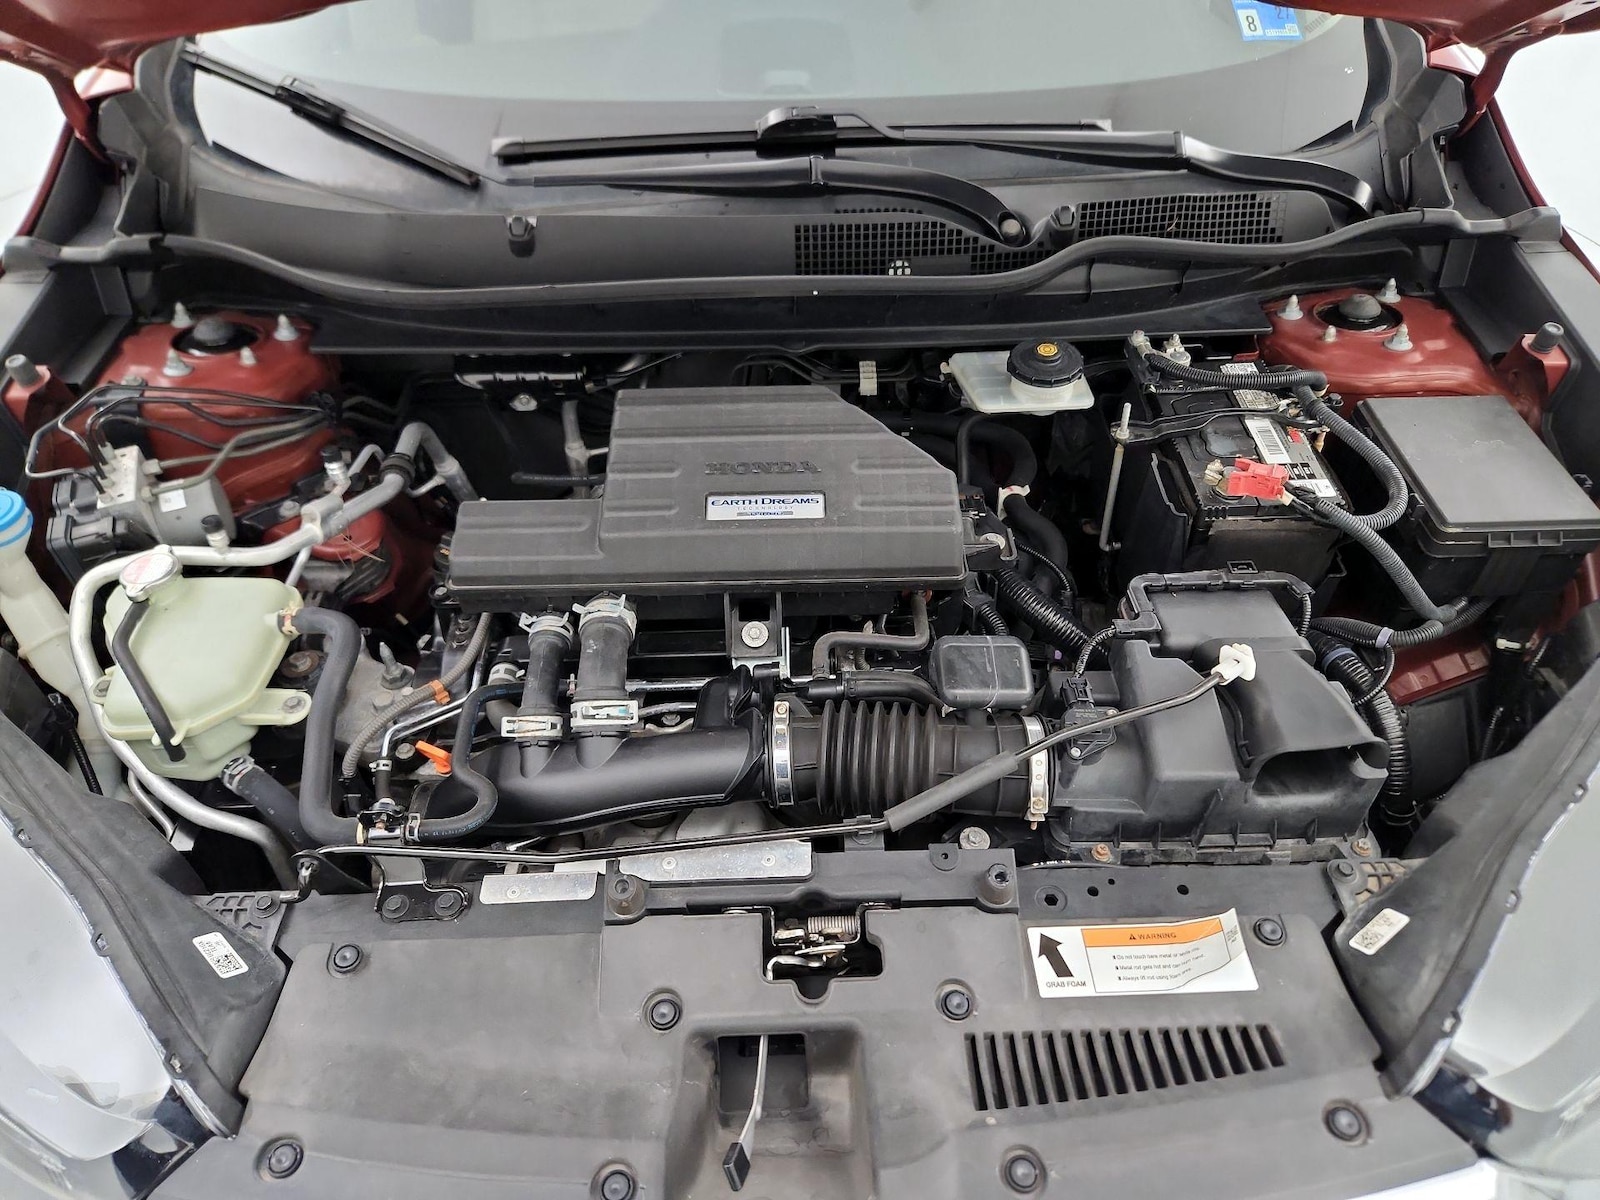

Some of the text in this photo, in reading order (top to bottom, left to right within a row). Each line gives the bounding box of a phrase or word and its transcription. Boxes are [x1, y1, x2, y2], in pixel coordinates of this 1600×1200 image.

[1246, 15, 1257, 32] 8
[705, 461, 821, 475] HONDA
[1138, 932, 1177, 940] WARNING
